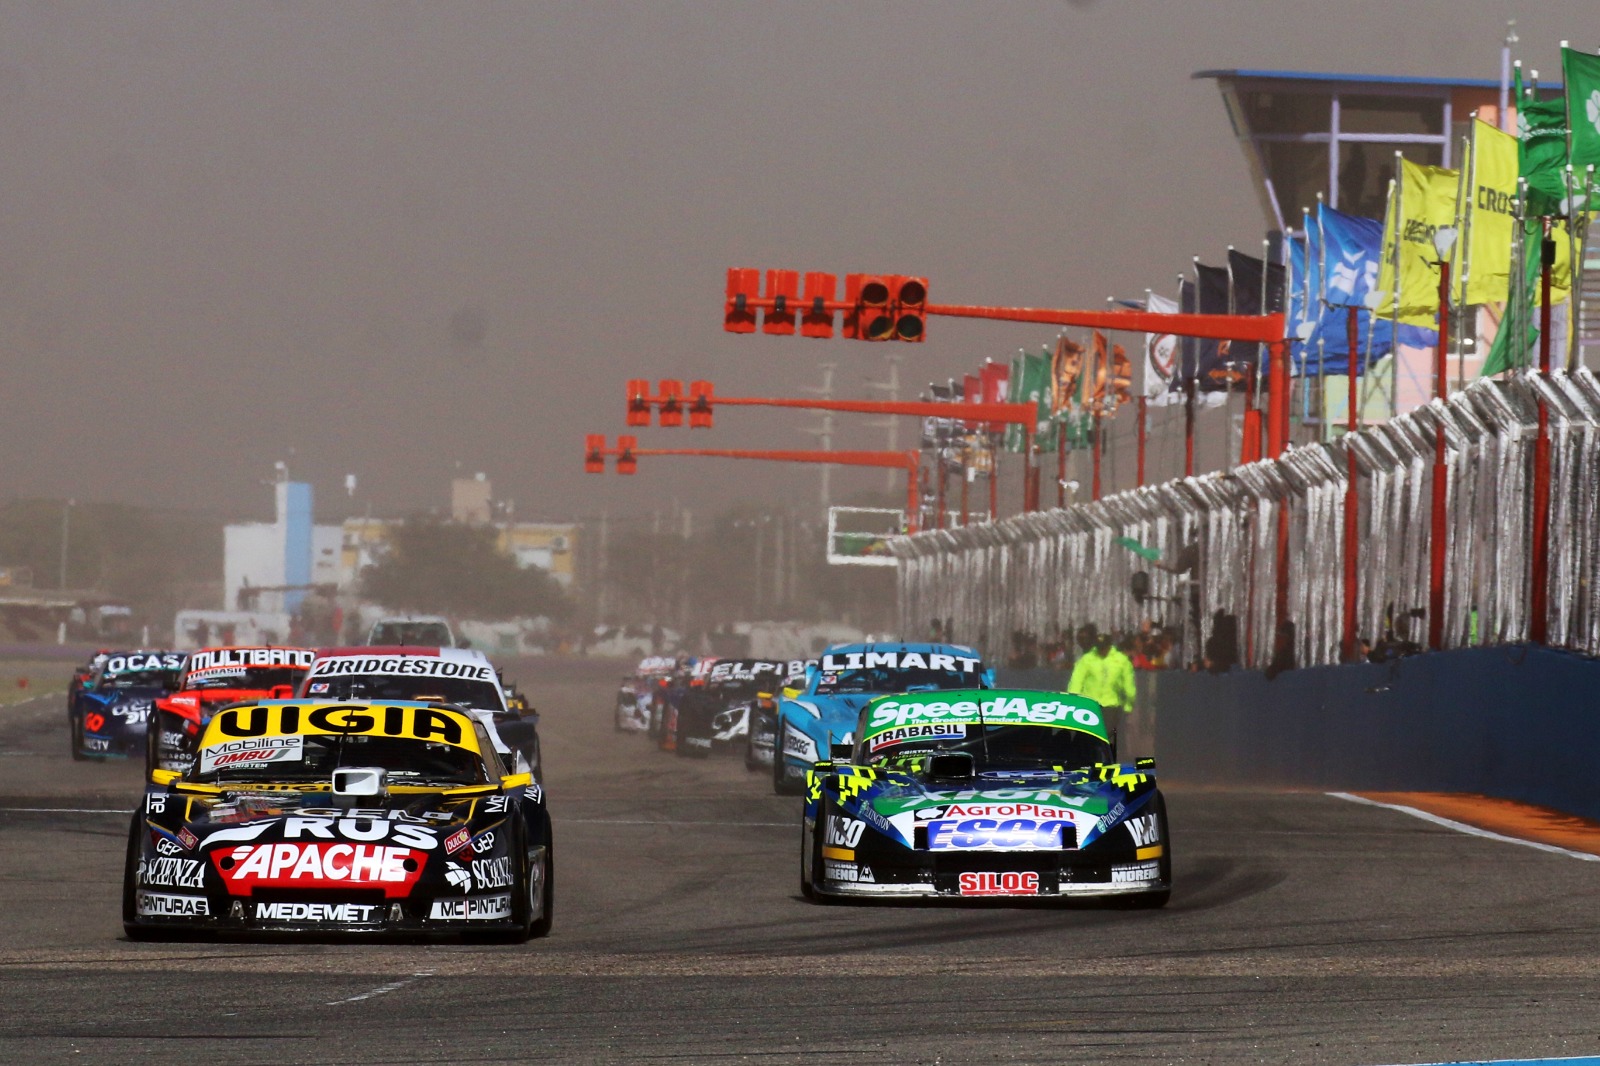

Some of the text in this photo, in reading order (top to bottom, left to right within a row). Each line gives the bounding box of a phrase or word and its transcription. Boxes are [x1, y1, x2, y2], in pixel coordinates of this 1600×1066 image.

[314, 659, 491, 679] BRIDGESTONE
[823, 652, 980, 673] LIMART
[870, 698, 1099, 728] SpeedAgro
[220, 706, 462, 744] UIGIA
[873, 725, 964, 745] TRABASIL
[205, 737, 300, 757] Mobiline
[214, 750, 276, 765] OMBU
[947, 804, 1075, 819] AgroPlan
[231, 844, 410, 881] APACHE
[960, 872, 1039, 891] SILOC
[256, 903, 375, 920] MEDEMET
[441, 901, 465, 916] MC
